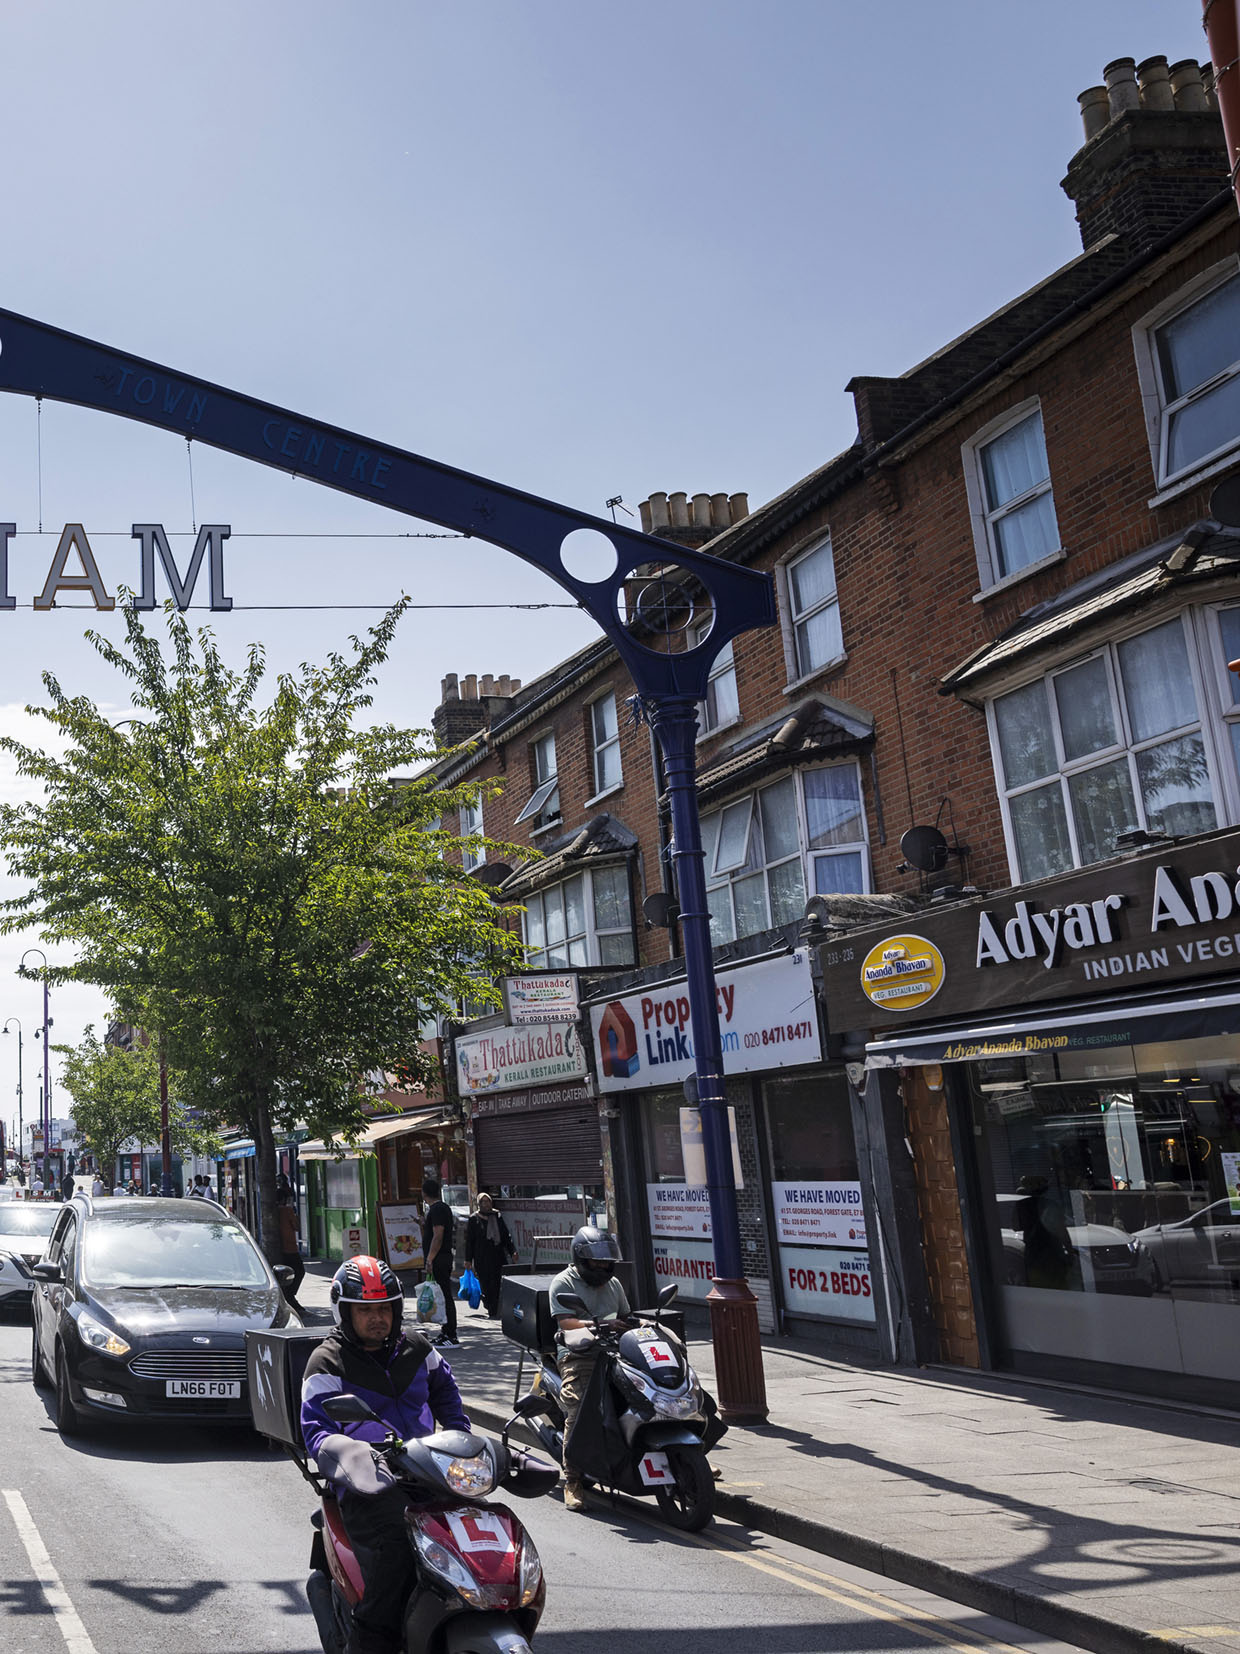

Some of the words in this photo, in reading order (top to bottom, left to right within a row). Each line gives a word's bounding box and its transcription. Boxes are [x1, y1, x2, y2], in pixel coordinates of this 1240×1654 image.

[115, 366, 208, 423] TOWN
[262, 420, 392, 488] CENTRE
[976, 895, 1123, 969] Adyar
[792, 954, 803, 965] 231
[883, 950, 900, 961] Adyar
[1083, 947, 1169, 980] INDIAN
[1177, 933, 1240, 963] VEG
[866, 965, 893, 980] Ananda
[896, 959, 926, 974] Bhavan
[513, 978, 565, 990] Thattukada
[888, 984, 924, 997] RESTAURANT
[641, 982, 735, 1031] Propty
[744, 1033, 760, 1049] 020
[762, 1026, 785, 1045] 8471
[787, 1021, 812, 1042] 8471
[1086, 1032, 1131, 1045] RESTAURANT
[480, 1024, 563, 1072] Thattukada
[943, 1043, 980, 1061] Adyar
[980, 1038, 1022, 1055] Ananda
[1025, 1035, 1068, 1051] Bhavan
[504, 1069, 529, 1082] KERALA
[531, 1061, 576, 1078] RESTAURANT
[533, 1091, 561, 1104] OUTDOOR
[561, 1087, 591, 1101] CATERIN
[656, 1190, 666, 1201] WE
[667, 1190, 685, 1201] HAVE
[785, 1190, 798, 1203] WE
[800, 1190, 824, 1203] HAVE
[825, 1190, 860, 1204] MOVED
[840, 1261, 850, 1270] 020
[851, 1262, 865, 1271] 8471
[789, 1268, 817, 1292] FOR
[820, 1271, 829, 1292] 2
[831, 1272, 871, 1297] BEDS
[649, 1346, 670, 1362] L
[172, 1382, 206, 1395] LN66
[643, 1459, 665, 1478] L
[460, 1515, 499, 1542] L
